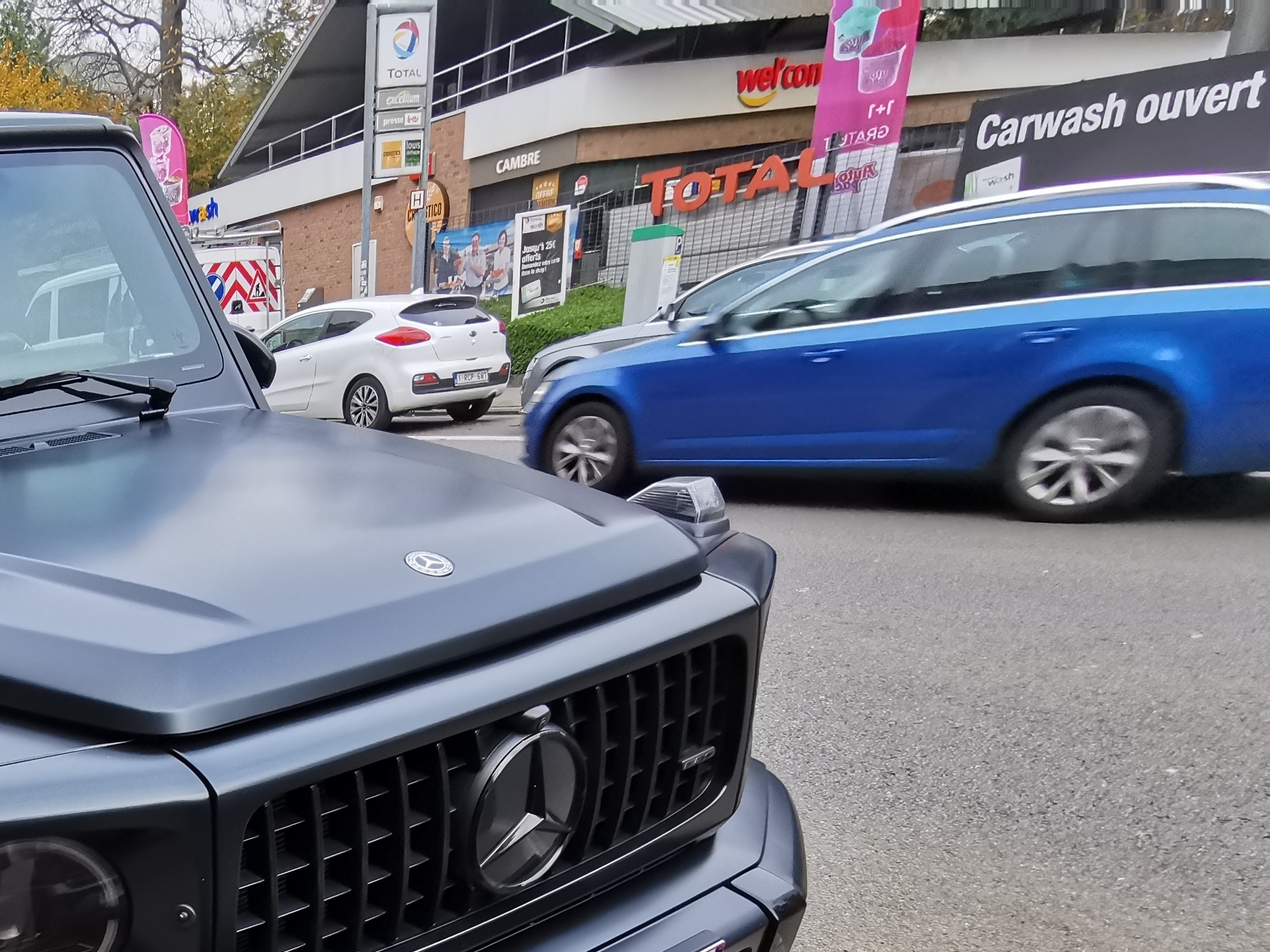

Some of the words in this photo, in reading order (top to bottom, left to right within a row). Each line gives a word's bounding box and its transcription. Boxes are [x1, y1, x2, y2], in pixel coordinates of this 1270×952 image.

[387, 68, 421, 79] TOTAL
[976, 92, 1126, 150] Carwash
[1136, 70, 1266, 124] ouvert
[383, 117, 404, 127] presse
[496, 153, 541, 174] CAMBRE
[641, 147, 835, 217] TOTAL
[522, 253, 541, 263] offerts
